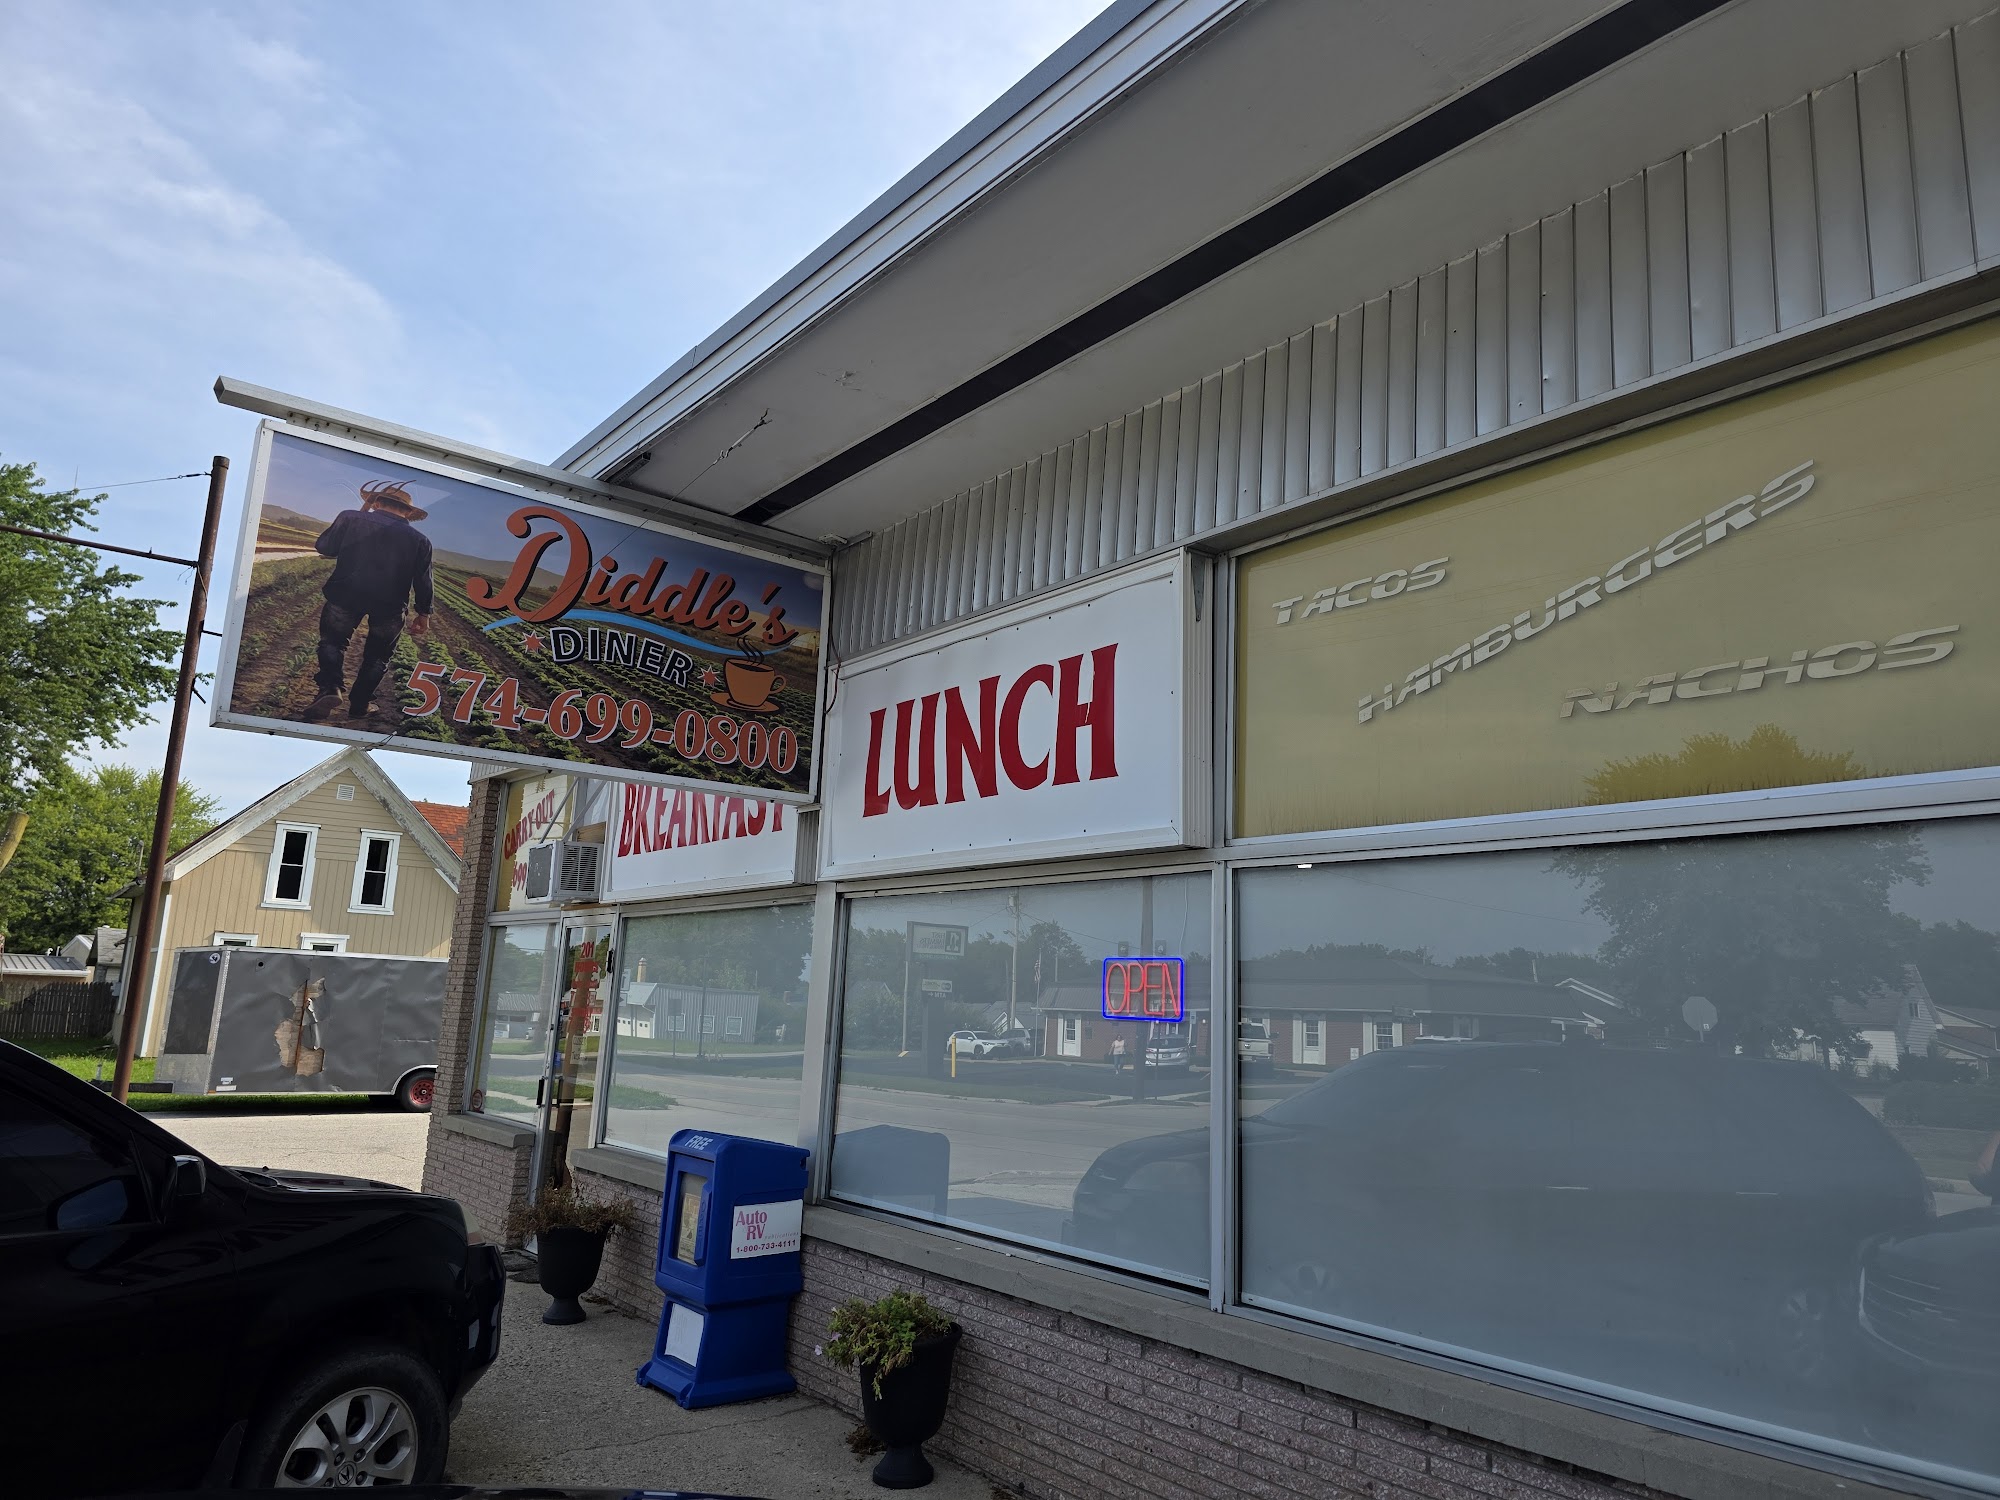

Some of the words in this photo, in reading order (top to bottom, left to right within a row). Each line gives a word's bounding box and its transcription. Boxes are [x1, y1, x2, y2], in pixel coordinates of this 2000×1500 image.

[467, 505, 799, 646] Diddle's
[1272, 556, 1451, 626] TACOS
[1357, 459, 1815, 725] HAMBURGERS
[549, 626, 695, 688] DINER
[1559, 624, 1960, 719] NACHOS
[402, 661, 798, 775] 574-699-0800
[862, 642, 1119, 818] LUNCH
[504, 809, 534, 859] CARRY
[535, 789, 554, 830] OUT
[580, 941, 595, 959] 201
[1105, 962, 1182, 1017] OPEN
[685, 1135, 712, 1150] FREE
[736, 1210, 767, 1226] Auto
[736, 1240, 796, 1253] 1-800-733-4111
[747, 1224, 765, 1240] RV
